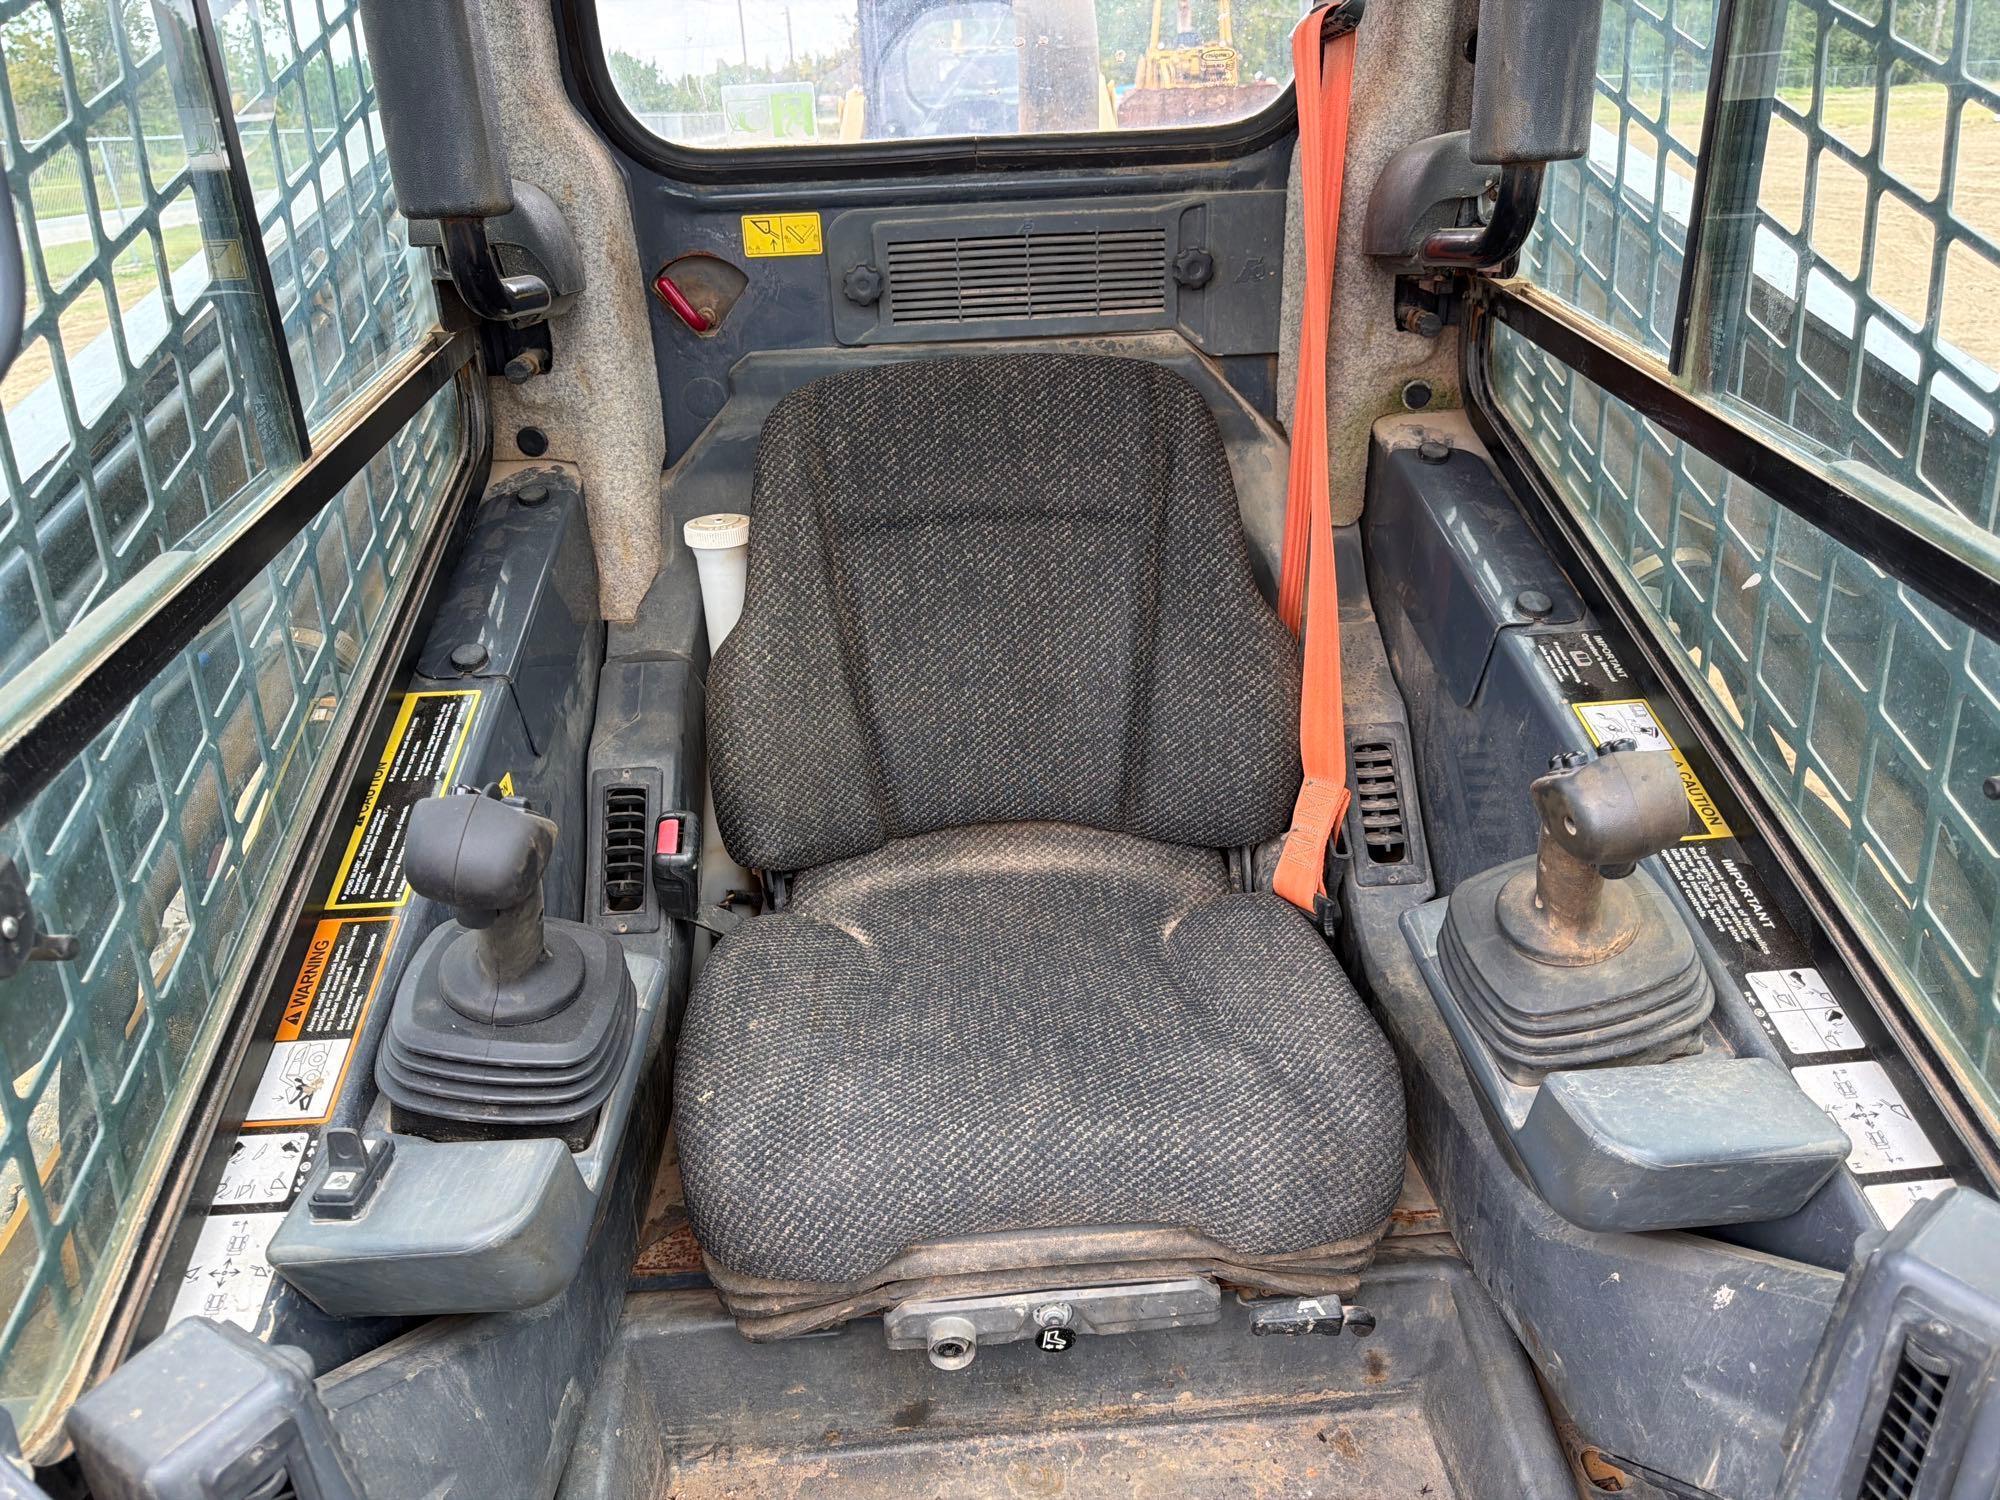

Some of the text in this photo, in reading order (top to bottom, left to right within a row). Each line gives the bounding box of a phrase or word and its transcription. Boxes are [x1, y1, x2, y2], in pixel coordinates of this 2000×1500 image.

[1594, 636, 1627, 677] IMPORTANT
[1600, 662, 1617, 682] Manual
[344, 879, 354, 895] AVOID
[350, 860, 361, 878] INJURY
[1661, 849, 1683, 879] operation
[1686, 889, 1706, 919] controls.
[1678, 861, 1688, 870] for
[1690, 881, 1710, 908] minutes
[1708, 910, 1725, 931] before
[1679, 848, 1694, 866] below
[1714, 904, 1725, 915] run
[1728, 926, 1742, 942] slow
[1688, 847, 1701, 859] and
[1718, 894, 1750, 938] temperatures
[1698, 846, 1706, 854] To
[1702, 856, 1723, 880] prevent
[1720, 881, 1740, 907] damage
[1743, 918, 1770, 954] hydraulics
[1722, 859, 1774, 928] IMPORTANT
[291, 940, 330, 1008] WARNING
[352, 967, 364, 987] Manual
[365, 933, 377, 957] complete
[306, 945, 344, 1031] Always install boom lock before
[316, 1008, 329, 1031] working
[332, 971, 342, 990] around
[343, 937, 355, 958] machine
[324, 1021, 332, 1031] the
[328, 1002, 339, 1020] loader
[335, 985, 345, 1001] boom
[341, 988, 357, 1018] Operator's
[337, 1019, 346, 1030] See
